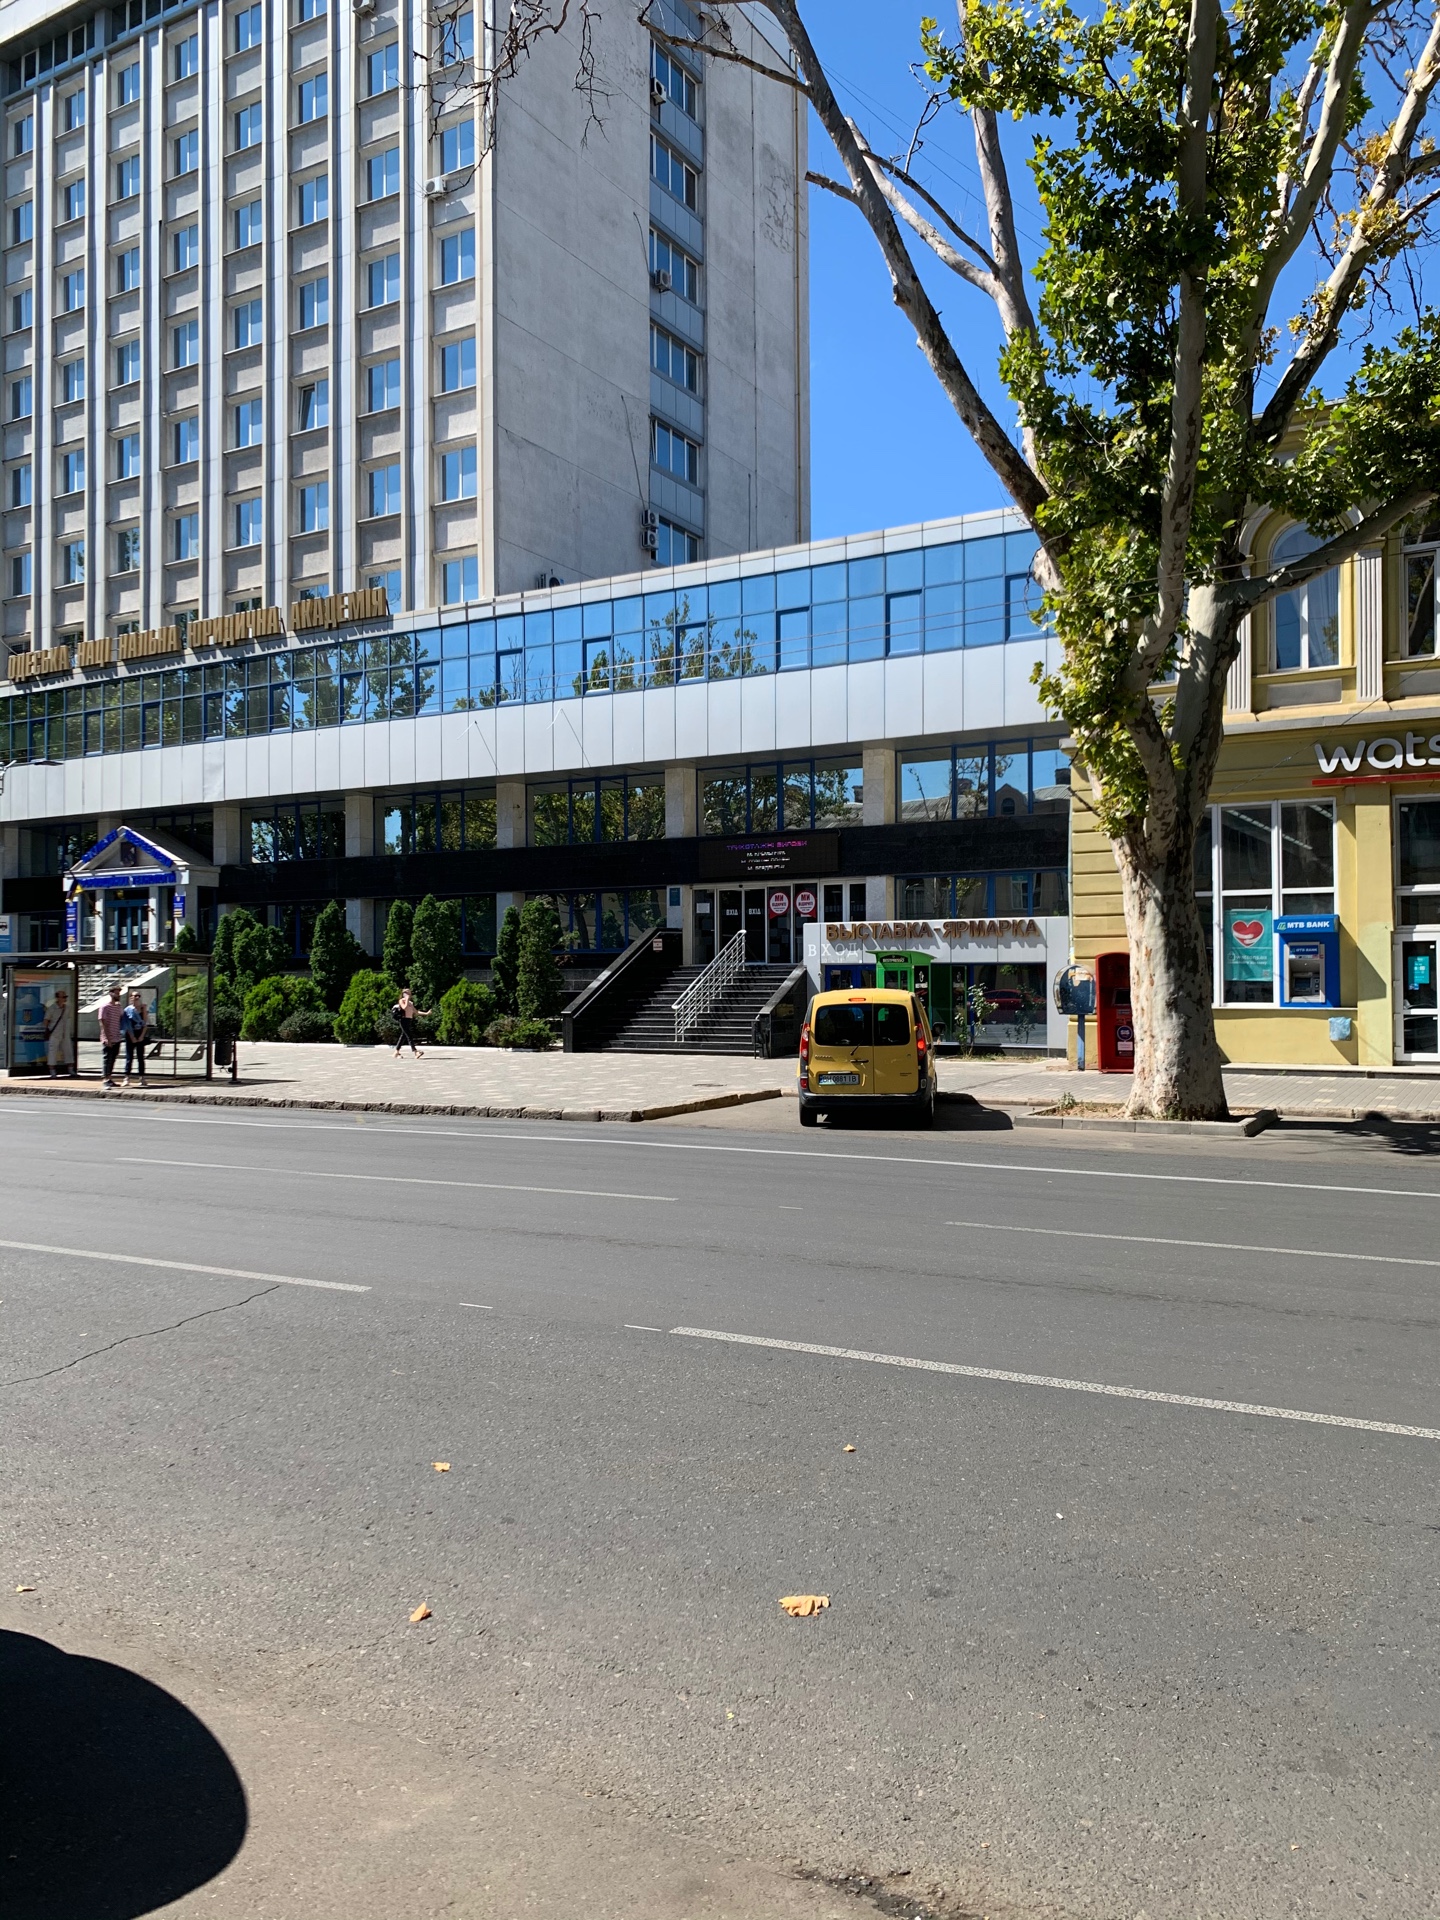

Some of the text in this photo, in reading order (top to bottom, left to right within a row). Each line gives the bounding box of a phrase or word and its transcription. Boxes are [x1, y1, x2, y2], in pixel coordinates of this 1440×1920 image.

[8, 645, 71, 682] ОДЕСЬКА
[188, 606, 281, 647] ЮРИДИЧНА
[291, 586, 387, 630] АКАДЕМІЯ
[1287, 920, 1330, 929] MTB BANK
[808, 942, 858, 957] ВХОД
